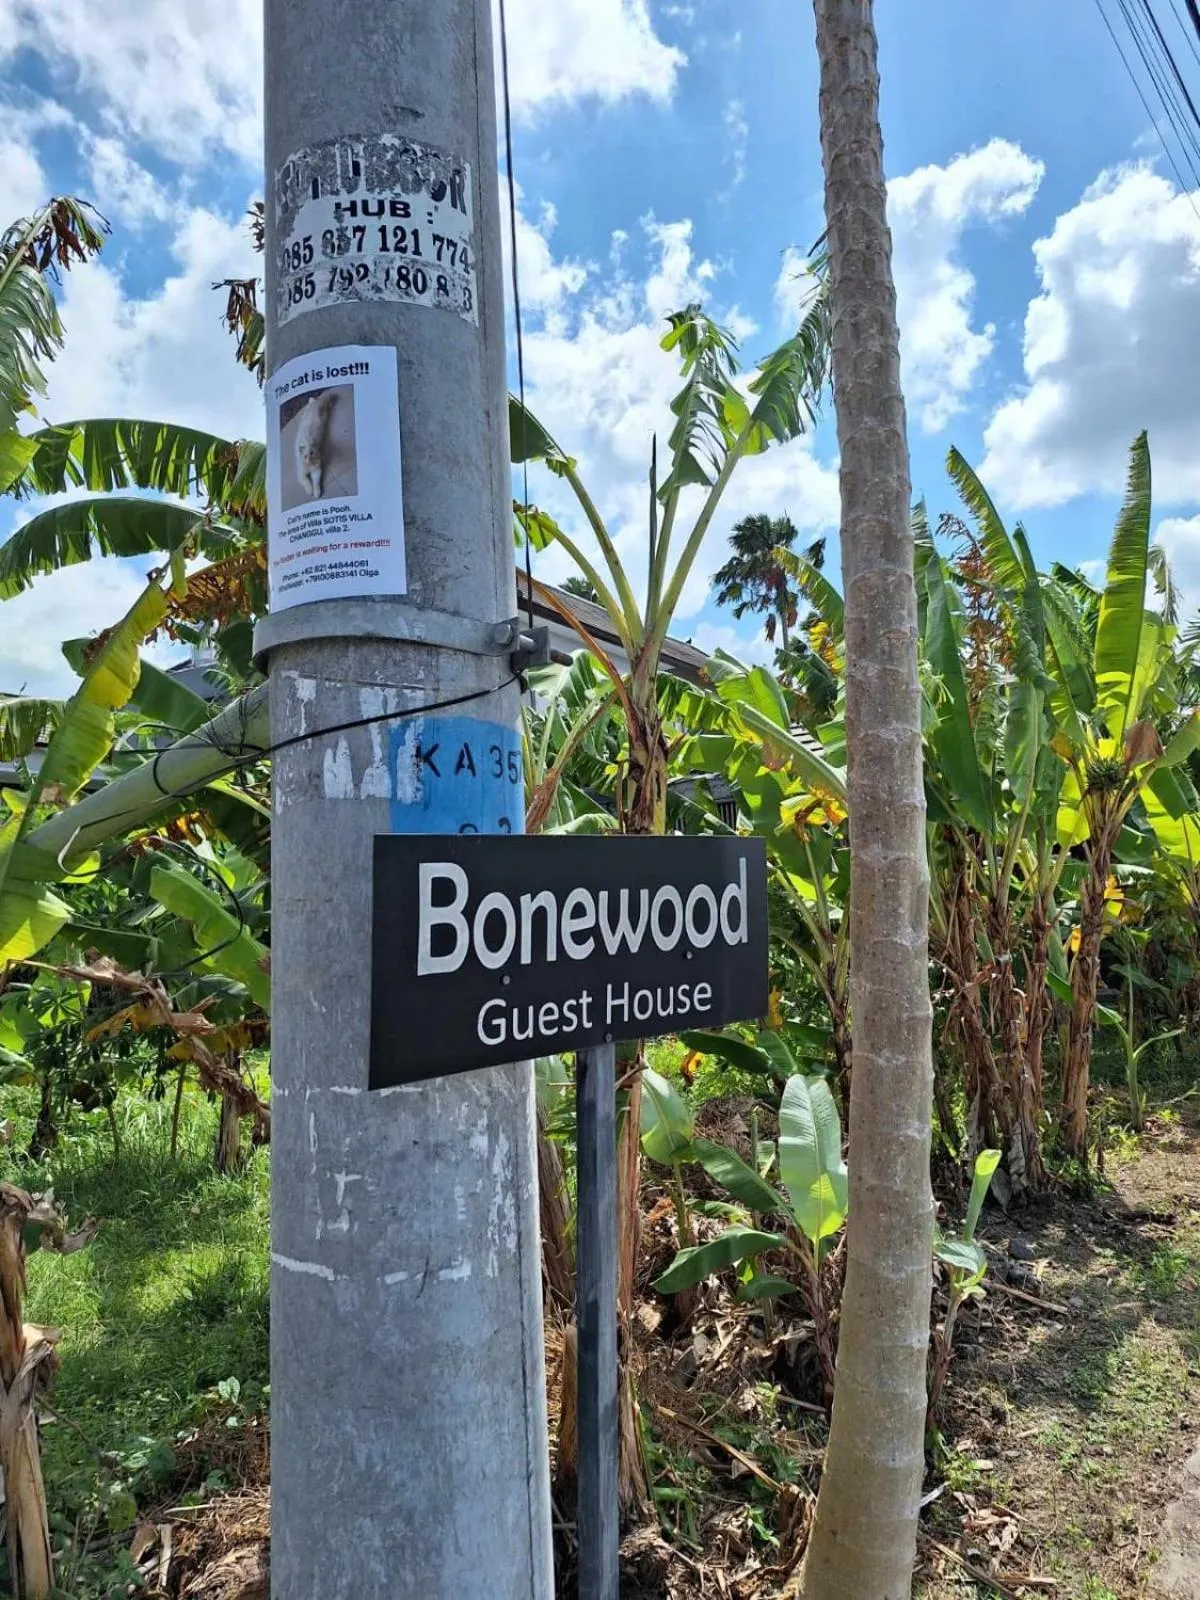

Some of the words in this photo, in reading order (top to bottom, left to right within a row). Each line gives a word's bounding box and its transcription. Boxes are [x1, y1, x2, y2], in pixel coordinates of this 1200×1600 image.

[334, 199, 412, 219] HUB
[377, 224, 423, 257] 121
[275, 383, 290, 399] The
[291, 372, 309, 389] cat
[311, 369, 324, 382] is
[326, 362, 370, 378] lost!!!
[303, 510, 321, 519] name
[322, 507, 329, 515] is
[348, 513, 373, 522] VILLA
[329, 542, 342, 551] for
[358, 568, 380, 578] Olga
[417, 856, 748, 976] Bonewood
[477, 990, 593, 1046] Guest
[605, 981, 712, 1025] House
